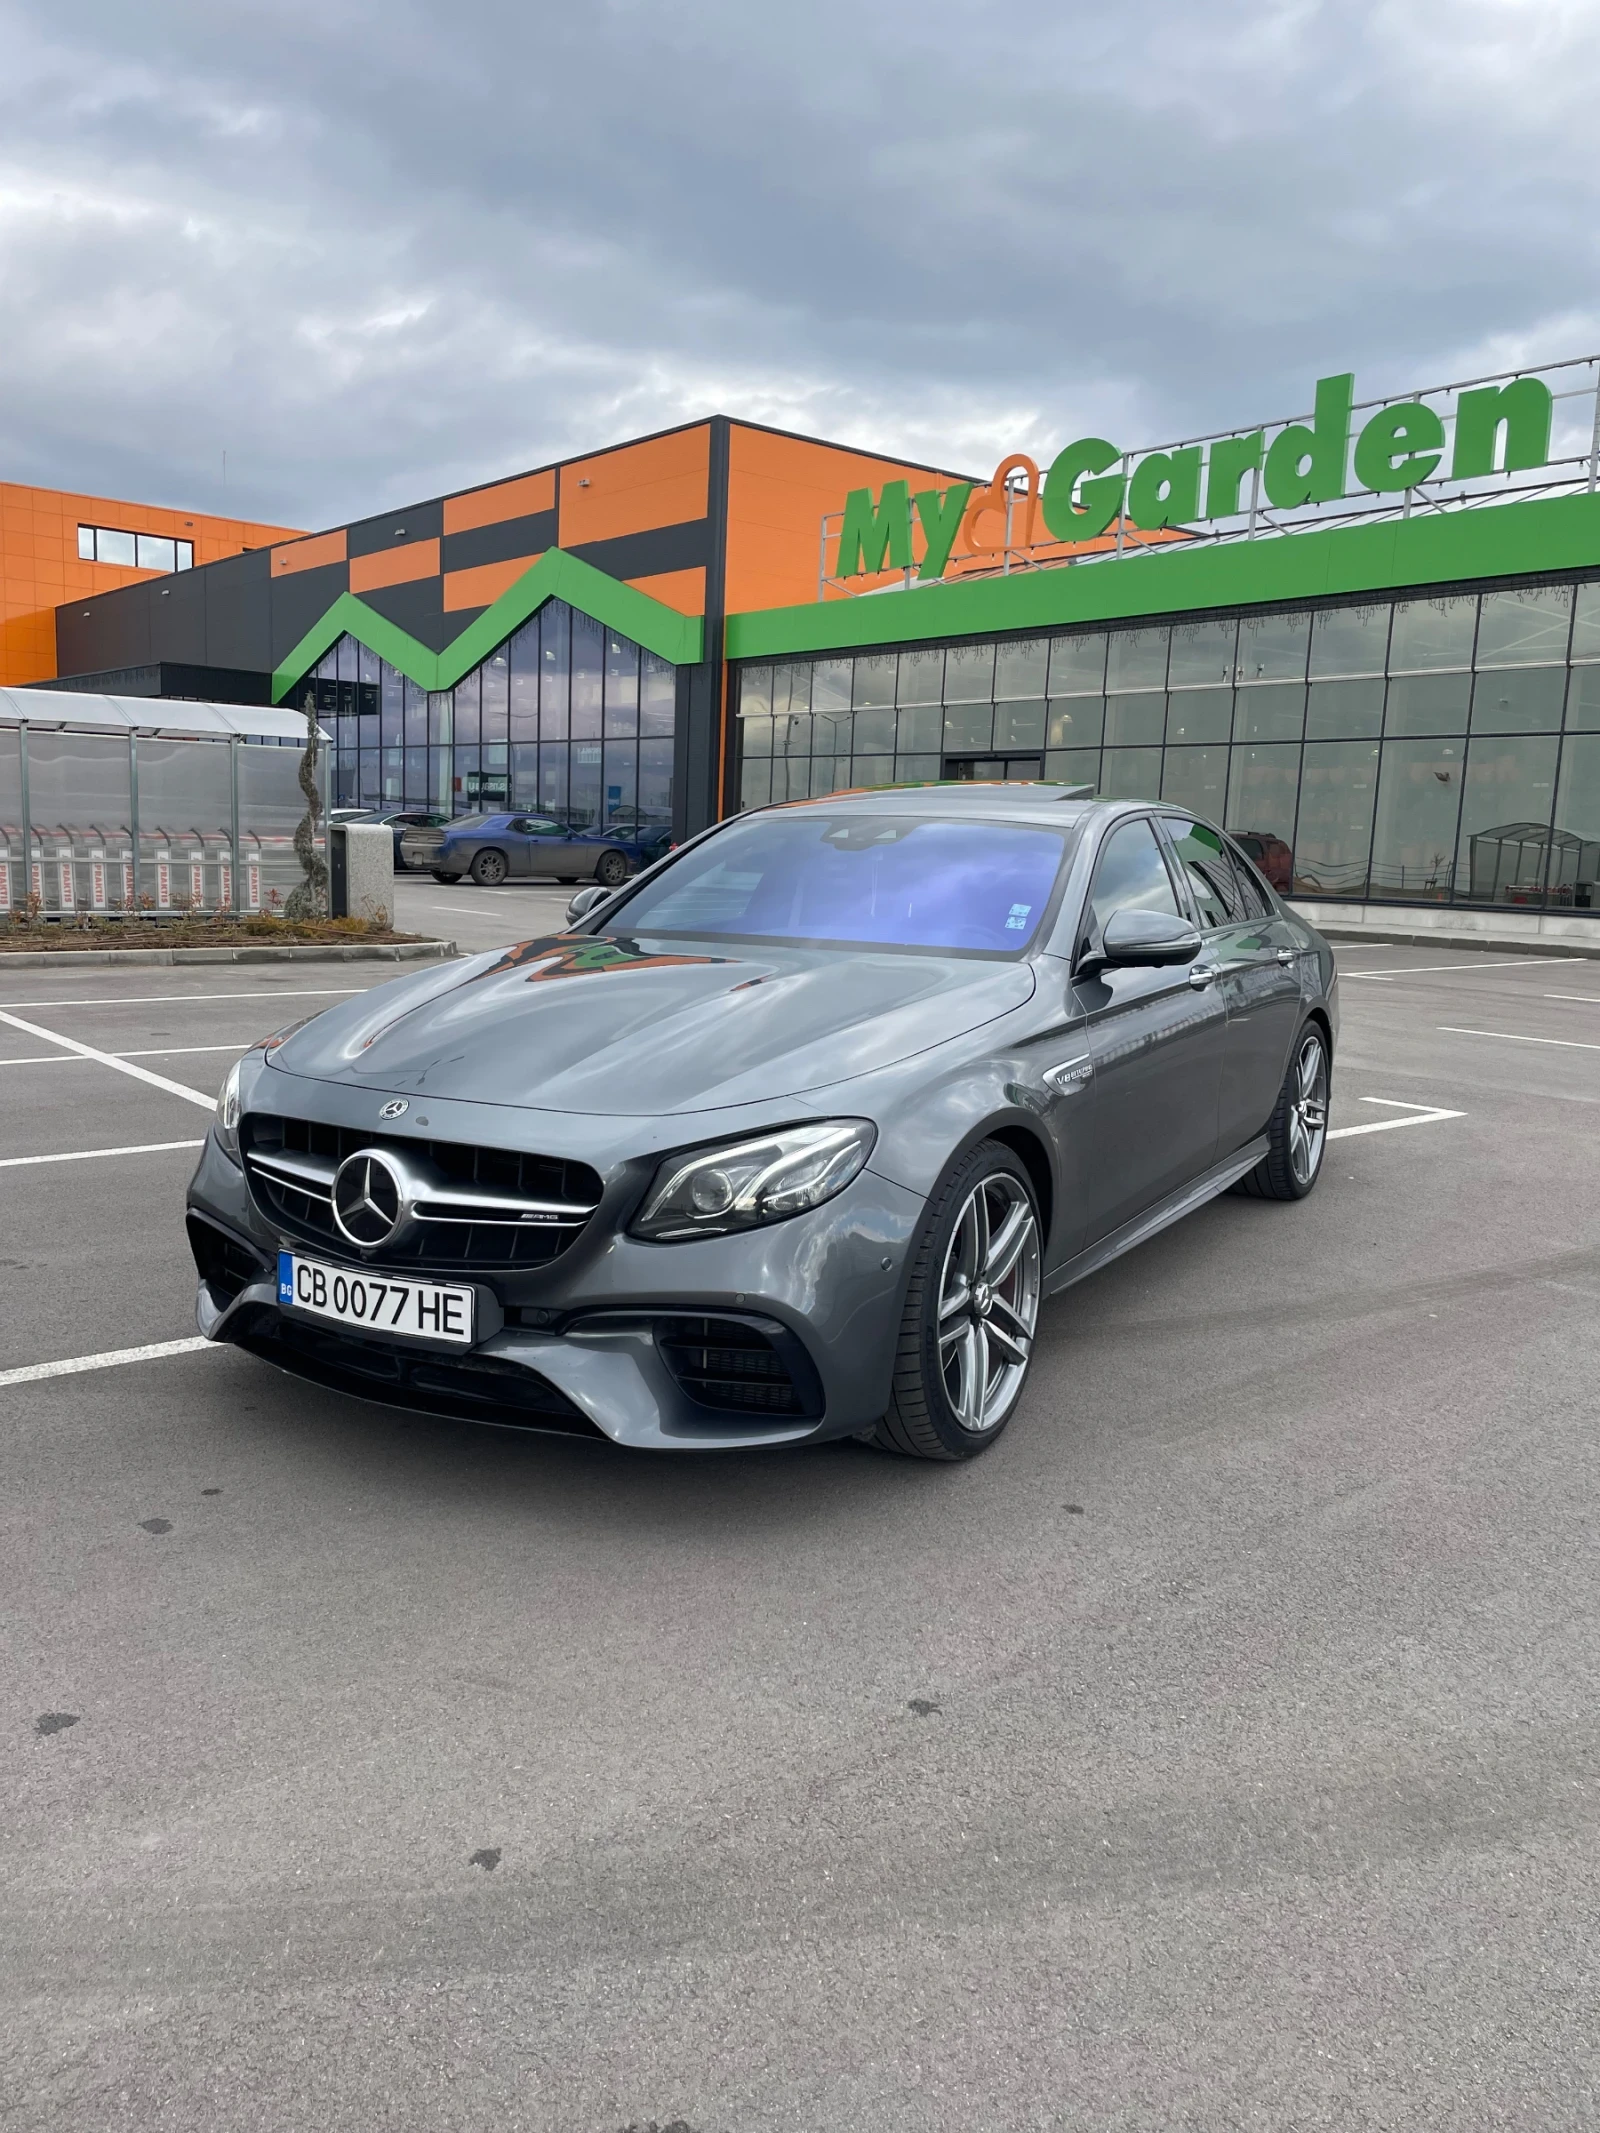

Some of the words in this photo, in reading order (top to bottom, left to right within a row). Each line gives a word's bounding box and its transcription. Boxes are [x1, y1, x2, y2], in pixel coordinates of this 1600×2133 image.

[835, 480, 974, 581] My
[1043, 373, 1552, 542] Garden
[62, 864, 72, 903] PRAKTIS
[94, 864, 104, 903] PRAKTIS
[160, 866, 169, 903] PRAKTIS
[251, 866, 259, 903] PRAKTIS
[1056, 1073, 1070, 1084] V8
[280, 1284, 292, 1296] BG
[297, 1264, 327, 1307] CB
[333, 1276, 410, 1325] 0077
[418, 1290, 464, 1335] HE
